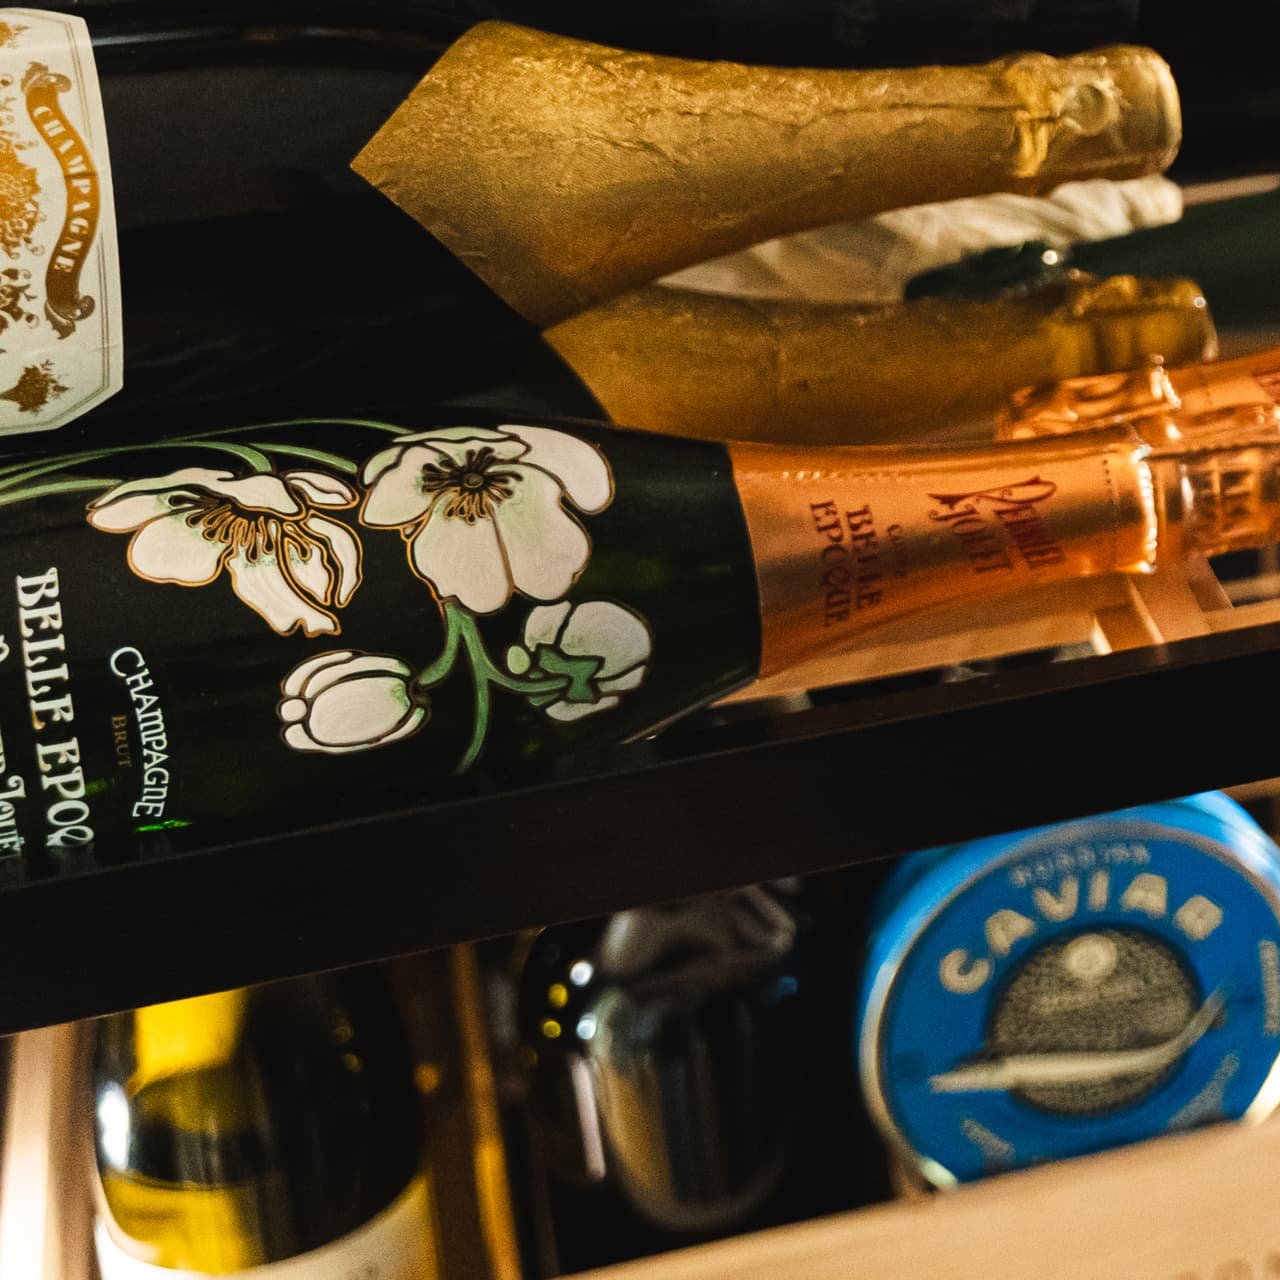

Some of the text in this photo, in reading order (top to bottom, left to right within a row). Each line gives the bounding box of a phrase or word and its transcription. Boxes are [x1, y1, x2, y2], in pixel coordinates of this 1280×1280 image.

[32, 104, 94, 274] CHAMPAGNE
[15, 567, 95, 848] BELLE EPOQ
[109, 646, 171, 819] CHAMPAGNE
[111, 714, 131, 768] BRUT
